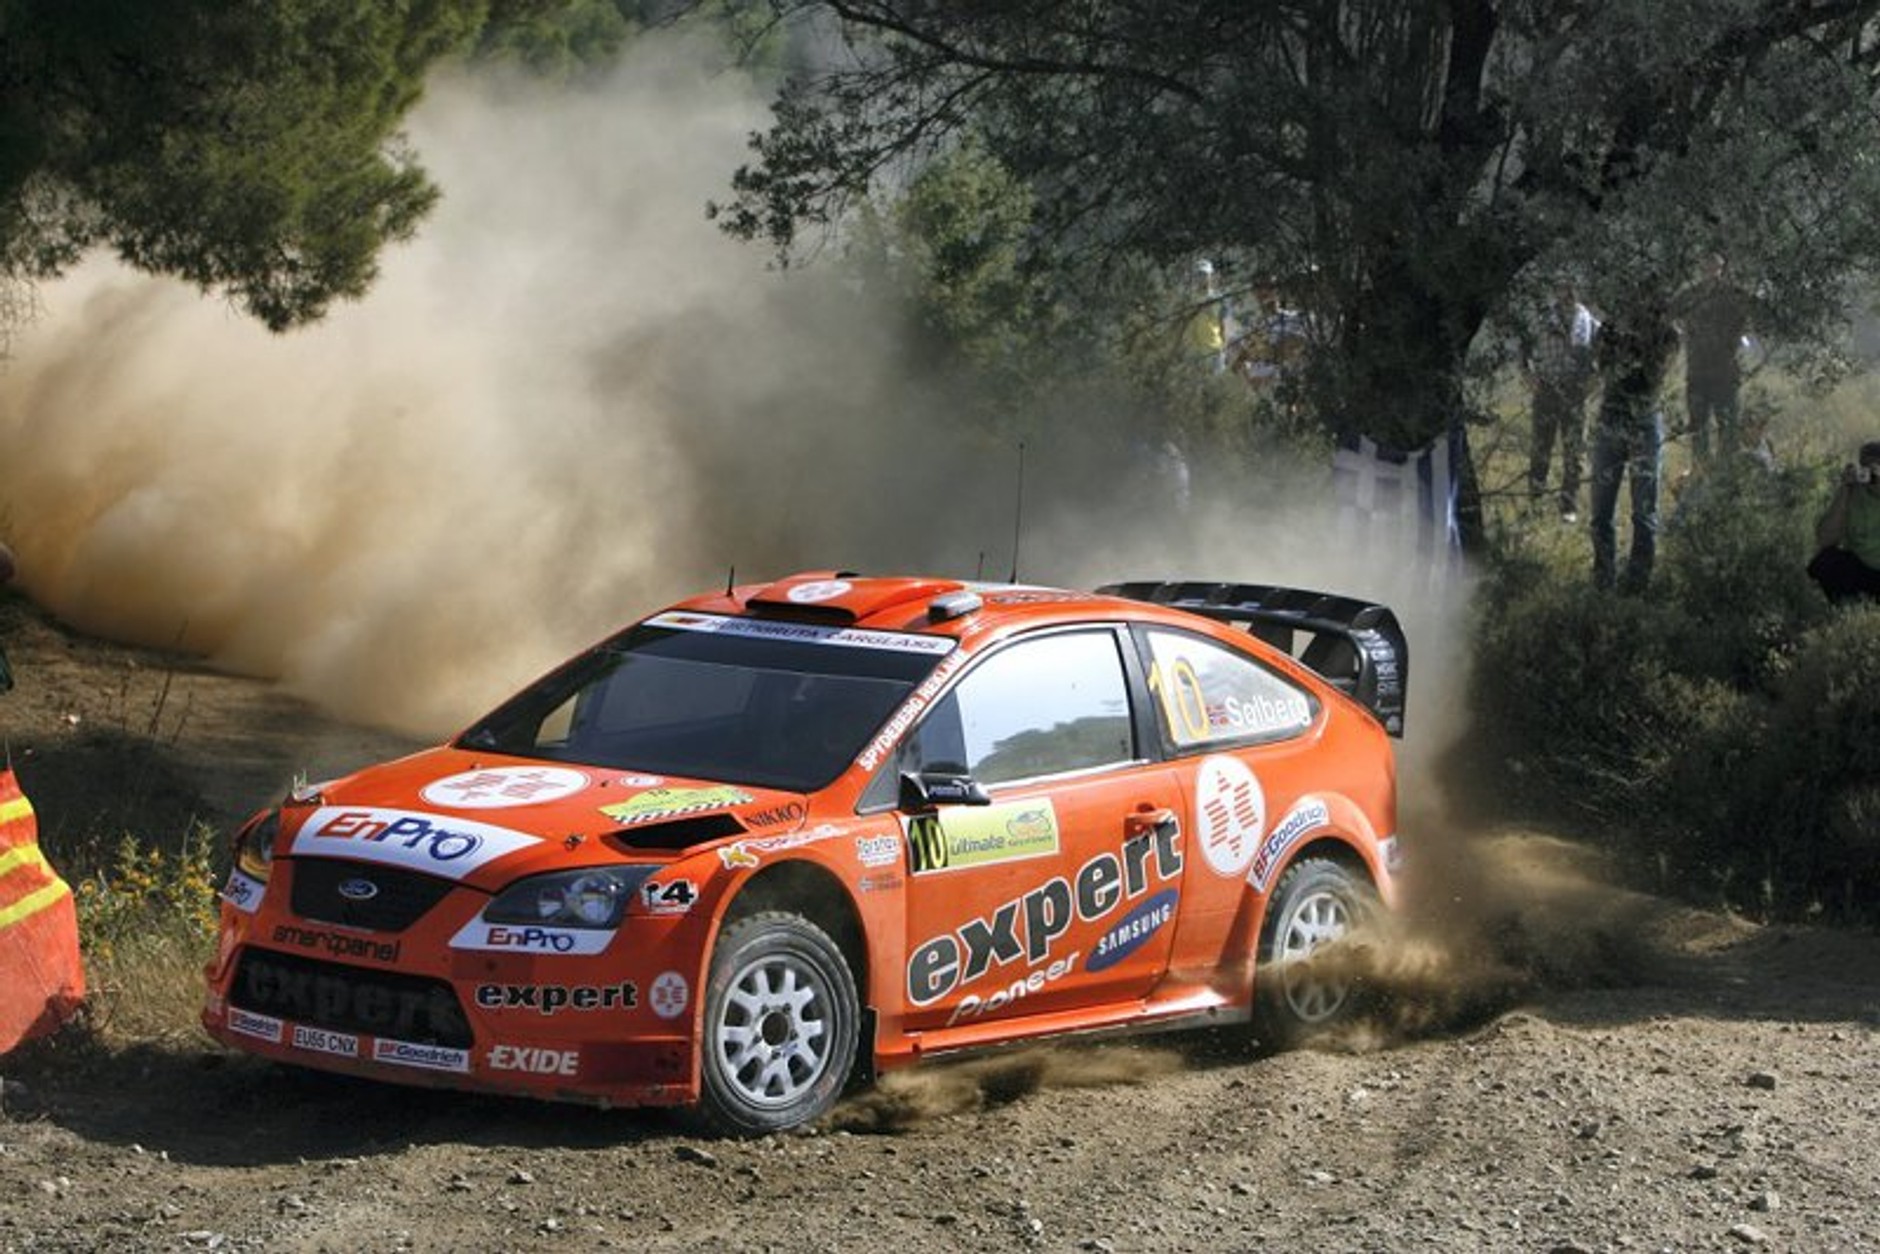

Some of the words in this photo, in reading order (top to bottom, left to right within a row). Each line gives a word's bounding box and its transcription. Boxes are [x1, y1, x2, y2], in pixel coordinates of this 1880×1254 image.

[1148, 655, 1210, 745] 10
[315, 812, 479, 861] EnPro
[743, 801, 803, 828] NIKKO
[911, 818, 946, 871] 10
[1252, 801, 1326, 880] BFGoodrich
[908, 808, 1184, 1006] expert
[1097, 903, 1171, 954] SAMSUNG
[487, 926, 575, 952] EnPro
[475, 981, 638, 1015] expert
[947, 951, 1081, 1026] Pioneer
[296, 1028, 326, 1049] EU55
[328, 1035, 357, 1054] CNX
[486, 1046, 581, 1076] EXIDE
